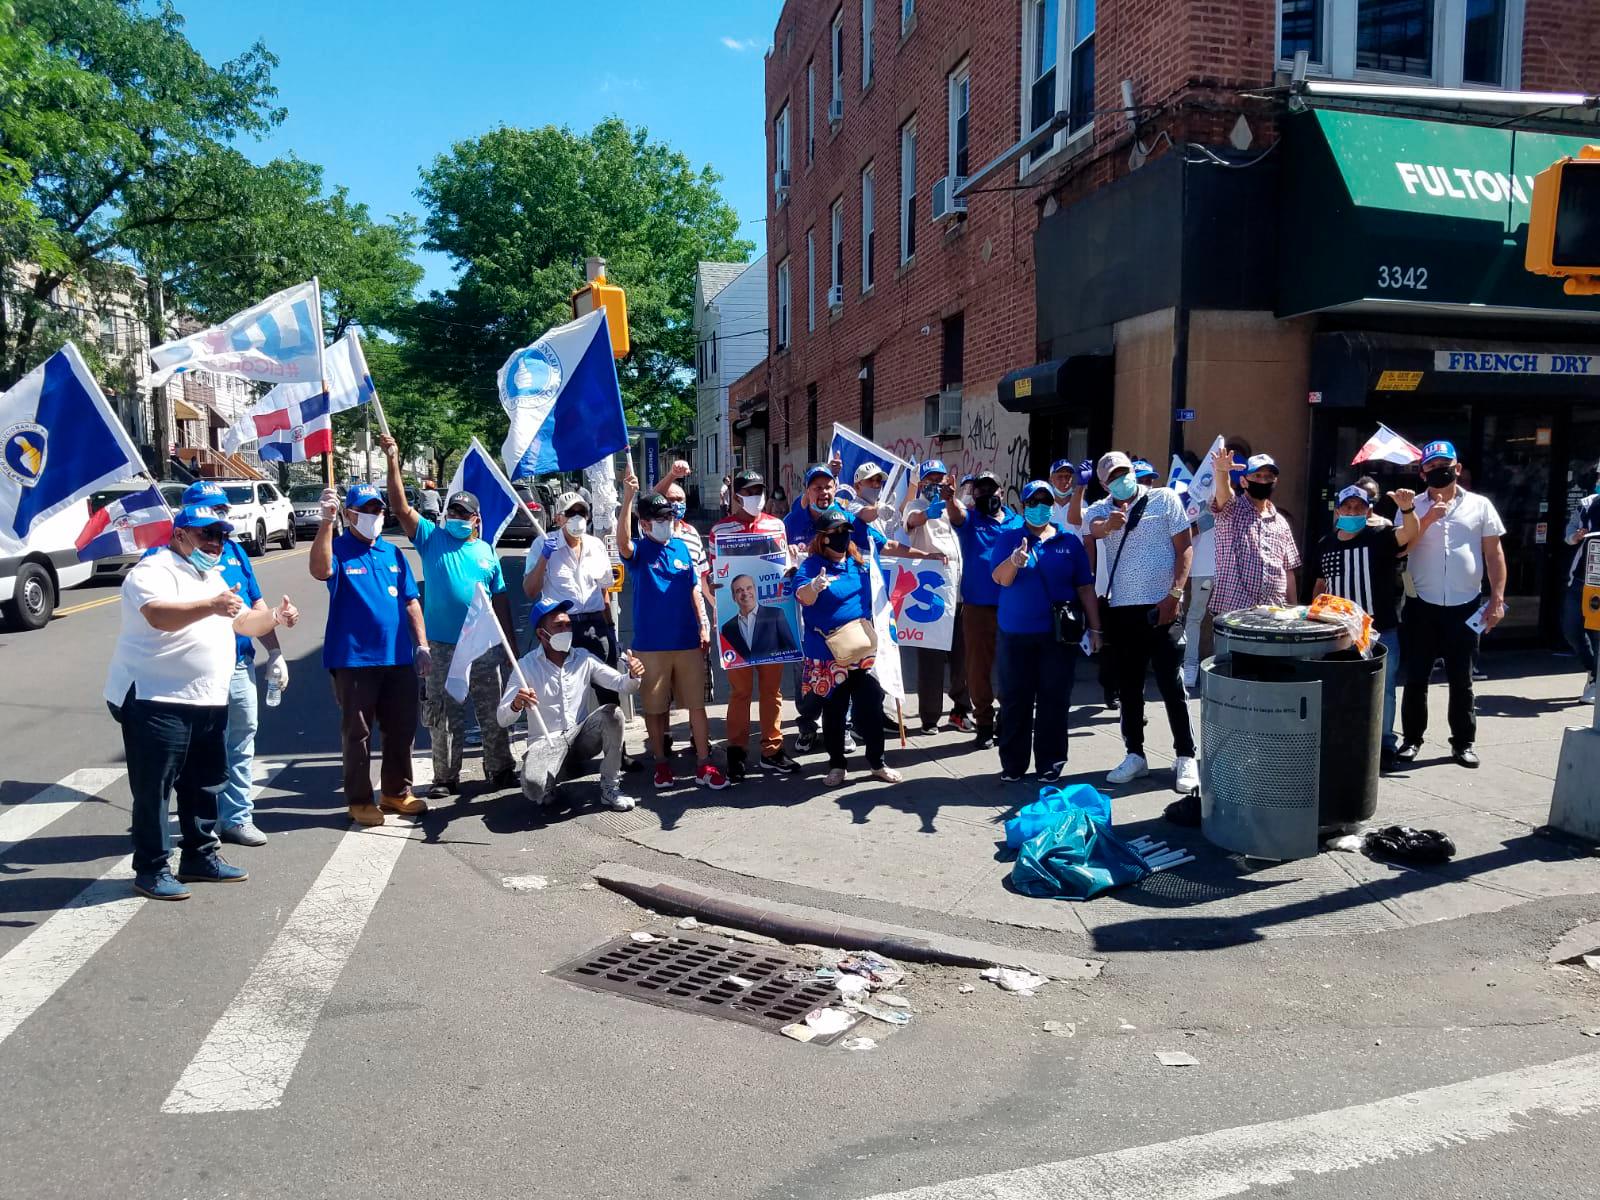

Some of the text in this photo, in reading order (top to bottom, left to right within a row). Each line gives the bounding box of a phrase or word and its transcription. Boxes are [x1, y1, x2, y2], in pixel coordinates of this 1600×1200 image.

[1395, 162, 1529, 205] FULTON
[1377, 265, 1428, 290] 3342
[1448, 352, 1593, 374] FRENCH DRY
[758, 572, 781, 582] VOTA
[757, 581, 793, 600] LUIS
